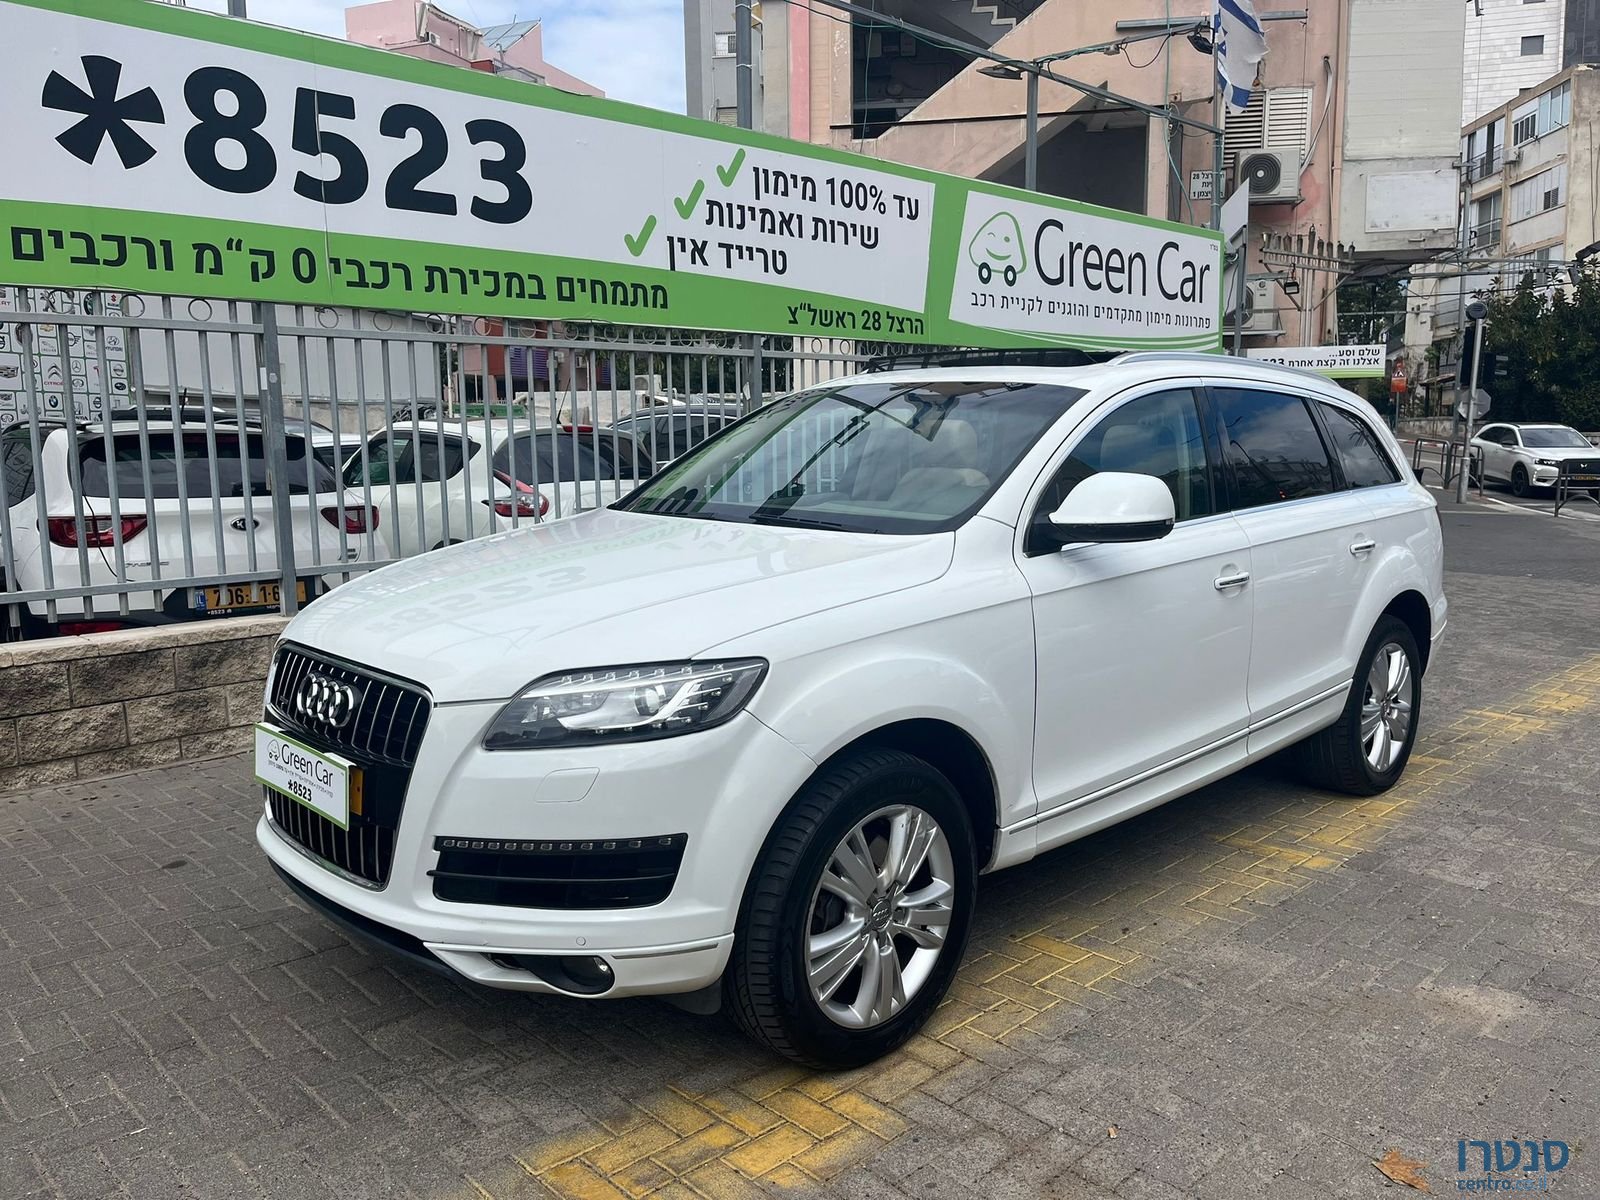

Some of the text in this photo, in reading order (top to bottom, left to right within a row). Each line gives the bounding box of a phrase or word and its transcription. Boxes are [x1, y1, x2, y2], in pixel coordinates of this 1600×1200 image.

[753, 167, 918, 219] עד 100% מימון
[706, 199, 878, 249] שירות ואמינות
[11, 226, 173, 271] ורכבים
[293, 248, 316, 283] 0
[667, 236, 787, 275] טרייד אין
[1035, 218, 1210, 303] Green Car
[329, 258, 412, 290] רכבי
[425, 264, 546, 300] במכירת
[557, 276, 669, 309] מתמחים
[862, 310, 881, 330] 28
[885, 312, 923, 335] הרצל
[971, 292, 1211, 329] פתרונות מימון מתקדמים והוגנים לקניית רכב
[1316, 359, 1336, 368] קצת
[1353, 357, 1380, 366] אצלנו
[1358, 348, 1380, 356] שלם
[281, 744, 334, 787] Green Car
